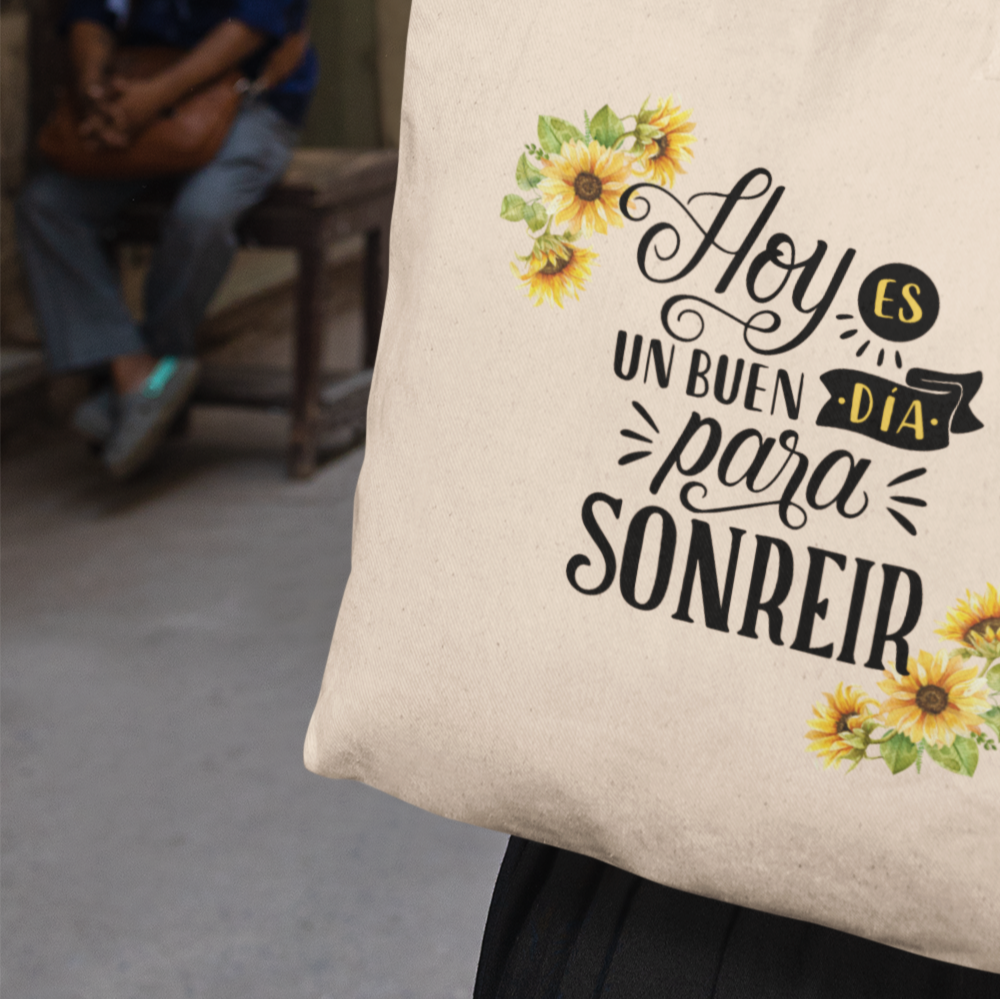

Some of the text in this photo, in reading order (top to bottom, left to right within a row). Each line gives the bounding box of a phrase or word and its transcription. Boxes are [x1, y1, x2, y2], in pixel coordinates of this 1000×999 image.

[619, 167, 923, 355] Hoy ES
[613, 330, 675, 388] UN
[685, 348, 804, 420] BUEN
[649, 411, 872, 530] para
[566, 491, 924, 676] SONREIR
